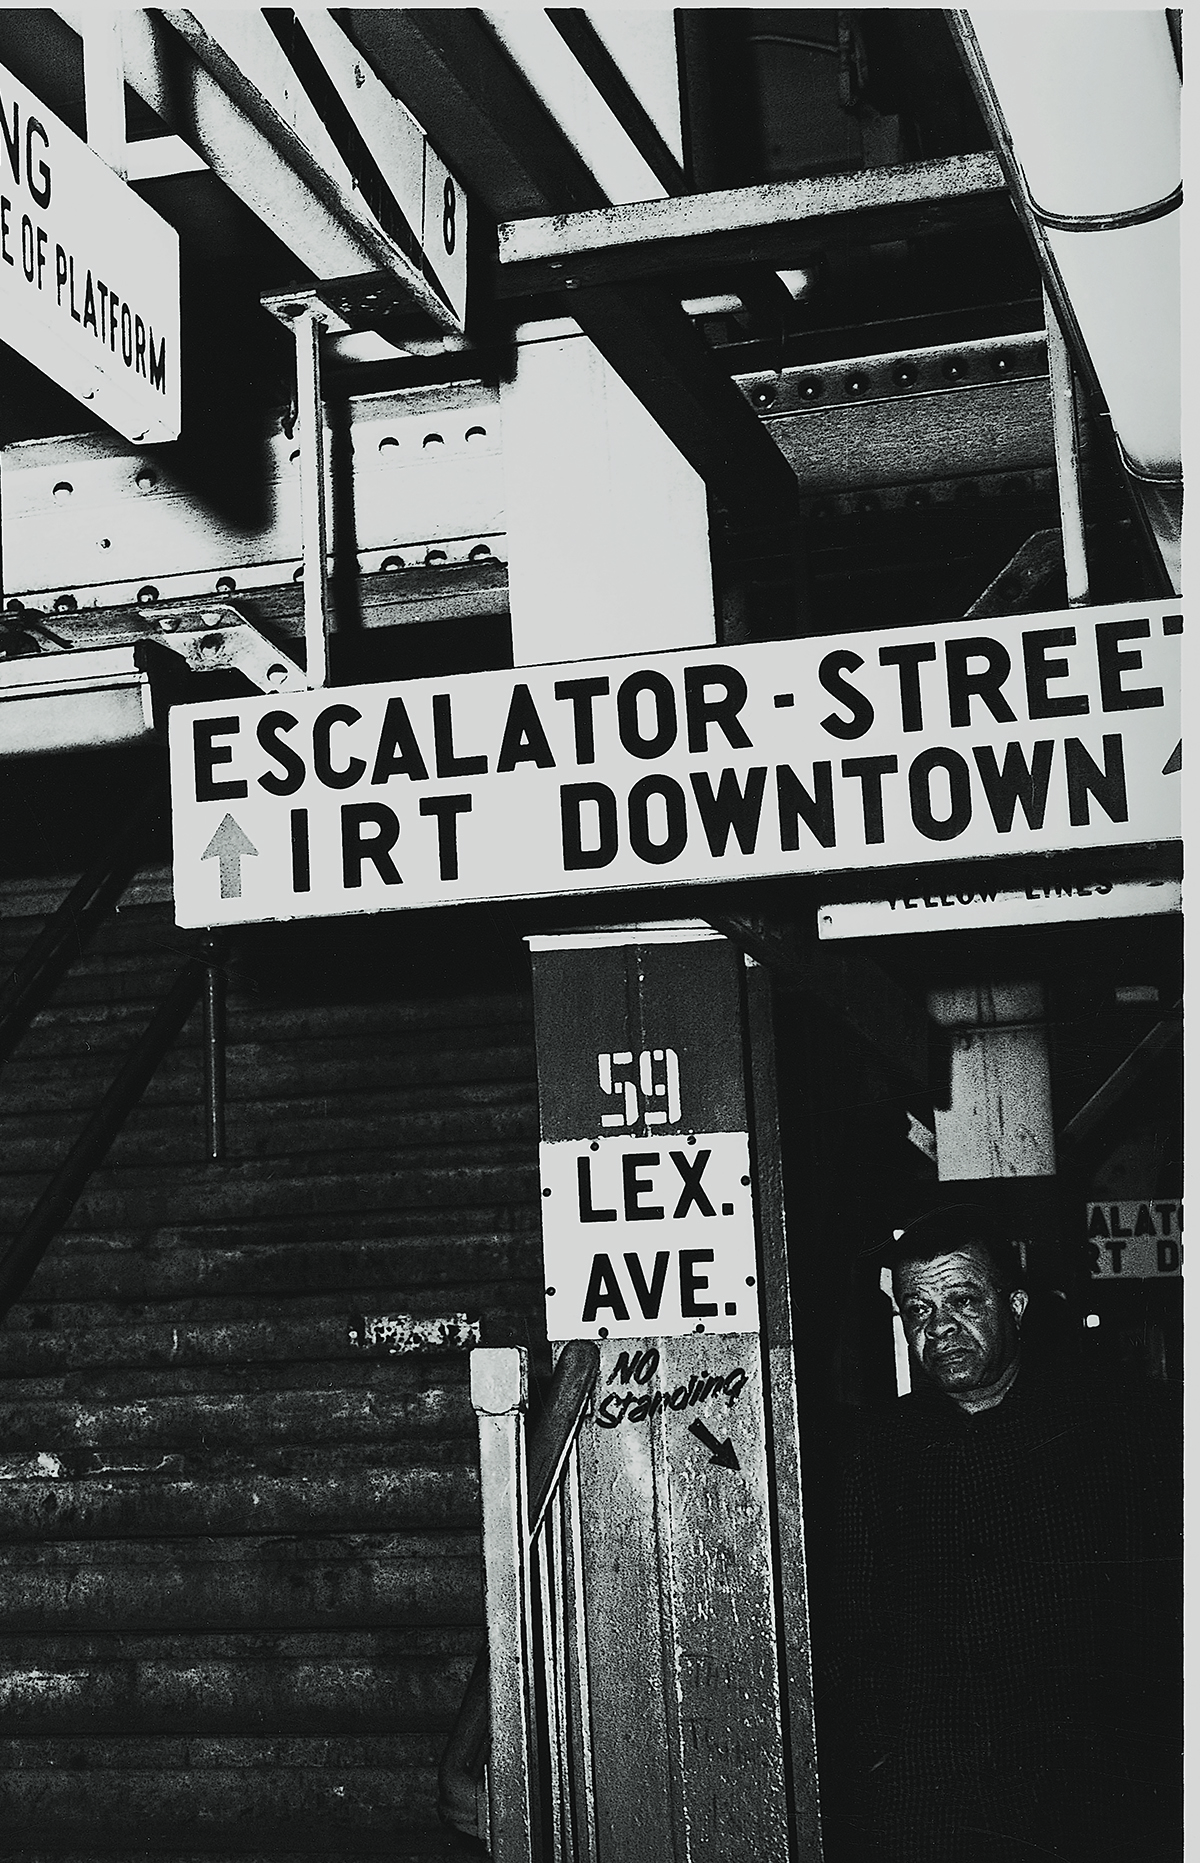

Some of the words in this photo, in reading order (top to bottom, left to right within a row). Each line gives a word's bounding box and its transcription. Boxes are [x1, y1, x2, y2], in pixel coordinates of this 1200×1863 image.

[442, 175, 457, 256] 8
[22, 213, 48, 291] OF
[56, 243, 166, 395] PLATFORM
[192, 663, 754, 803] ESCALATOR
[818, 614, 1184, 741] STREE
[290, 794, 473, 893] IRT
[560, 734, 1129, 871] DOWNTOWN
[598, 1048, 682, 1128] 59
[577, 1149, 735, 1224] LEX.
[581, 1248, 738, 1323] AVE.
[595, 1367, 749, 1429] Standing
[606, 1348, 661, 1386] NO
